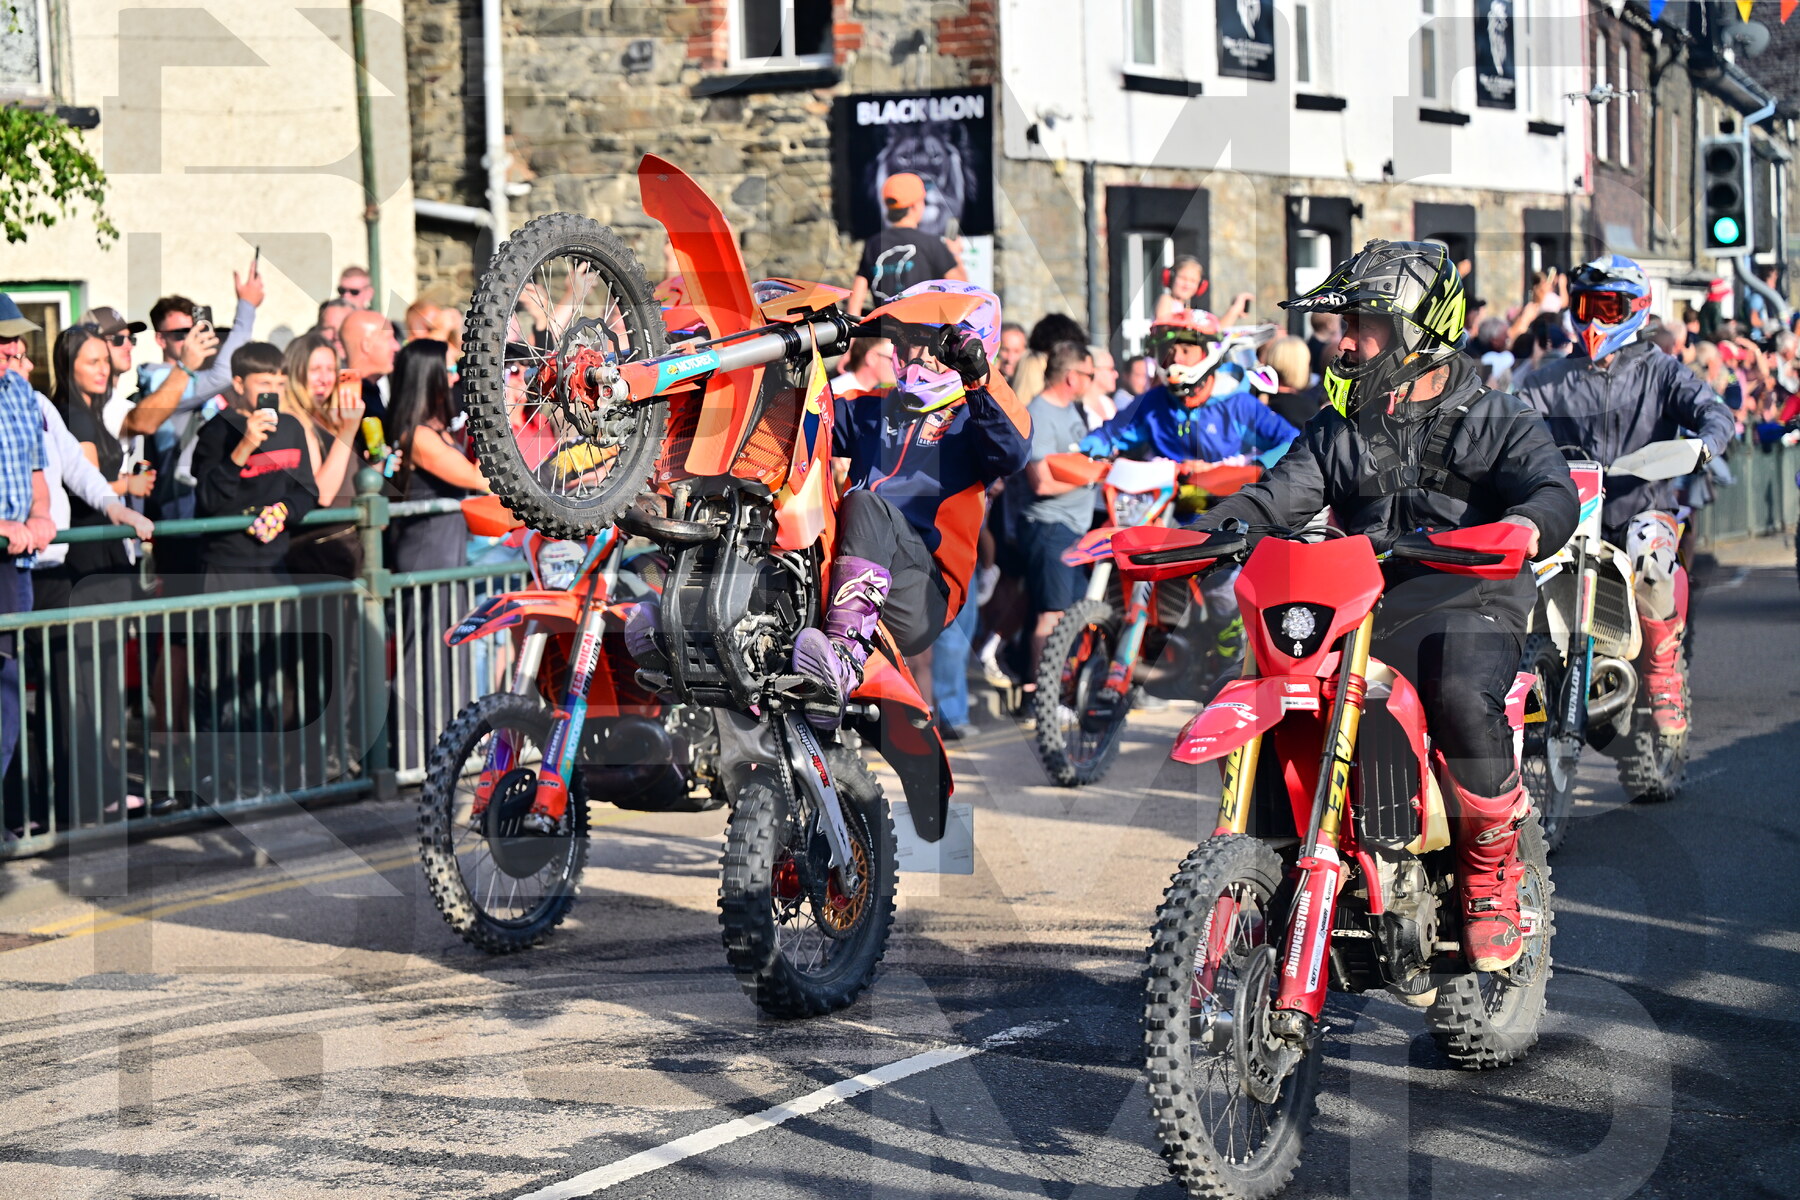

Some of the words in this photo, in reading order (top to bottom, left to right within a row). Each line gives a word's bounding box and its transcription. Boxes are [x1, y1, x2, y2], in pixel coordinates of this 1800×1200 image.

[856, 99, 927, 126] BLACK
[929, 95, 985, 121] LION
[676, 354, 715, 373] MOTOREX
[571, 633, 595, 696] TECHNICAL
[1567, 665, 1581, 725] DUNLOP
[566, 708, 587, 759] MOTOREX
[1285, 889, 1313, 979] BRIDGESTONE
